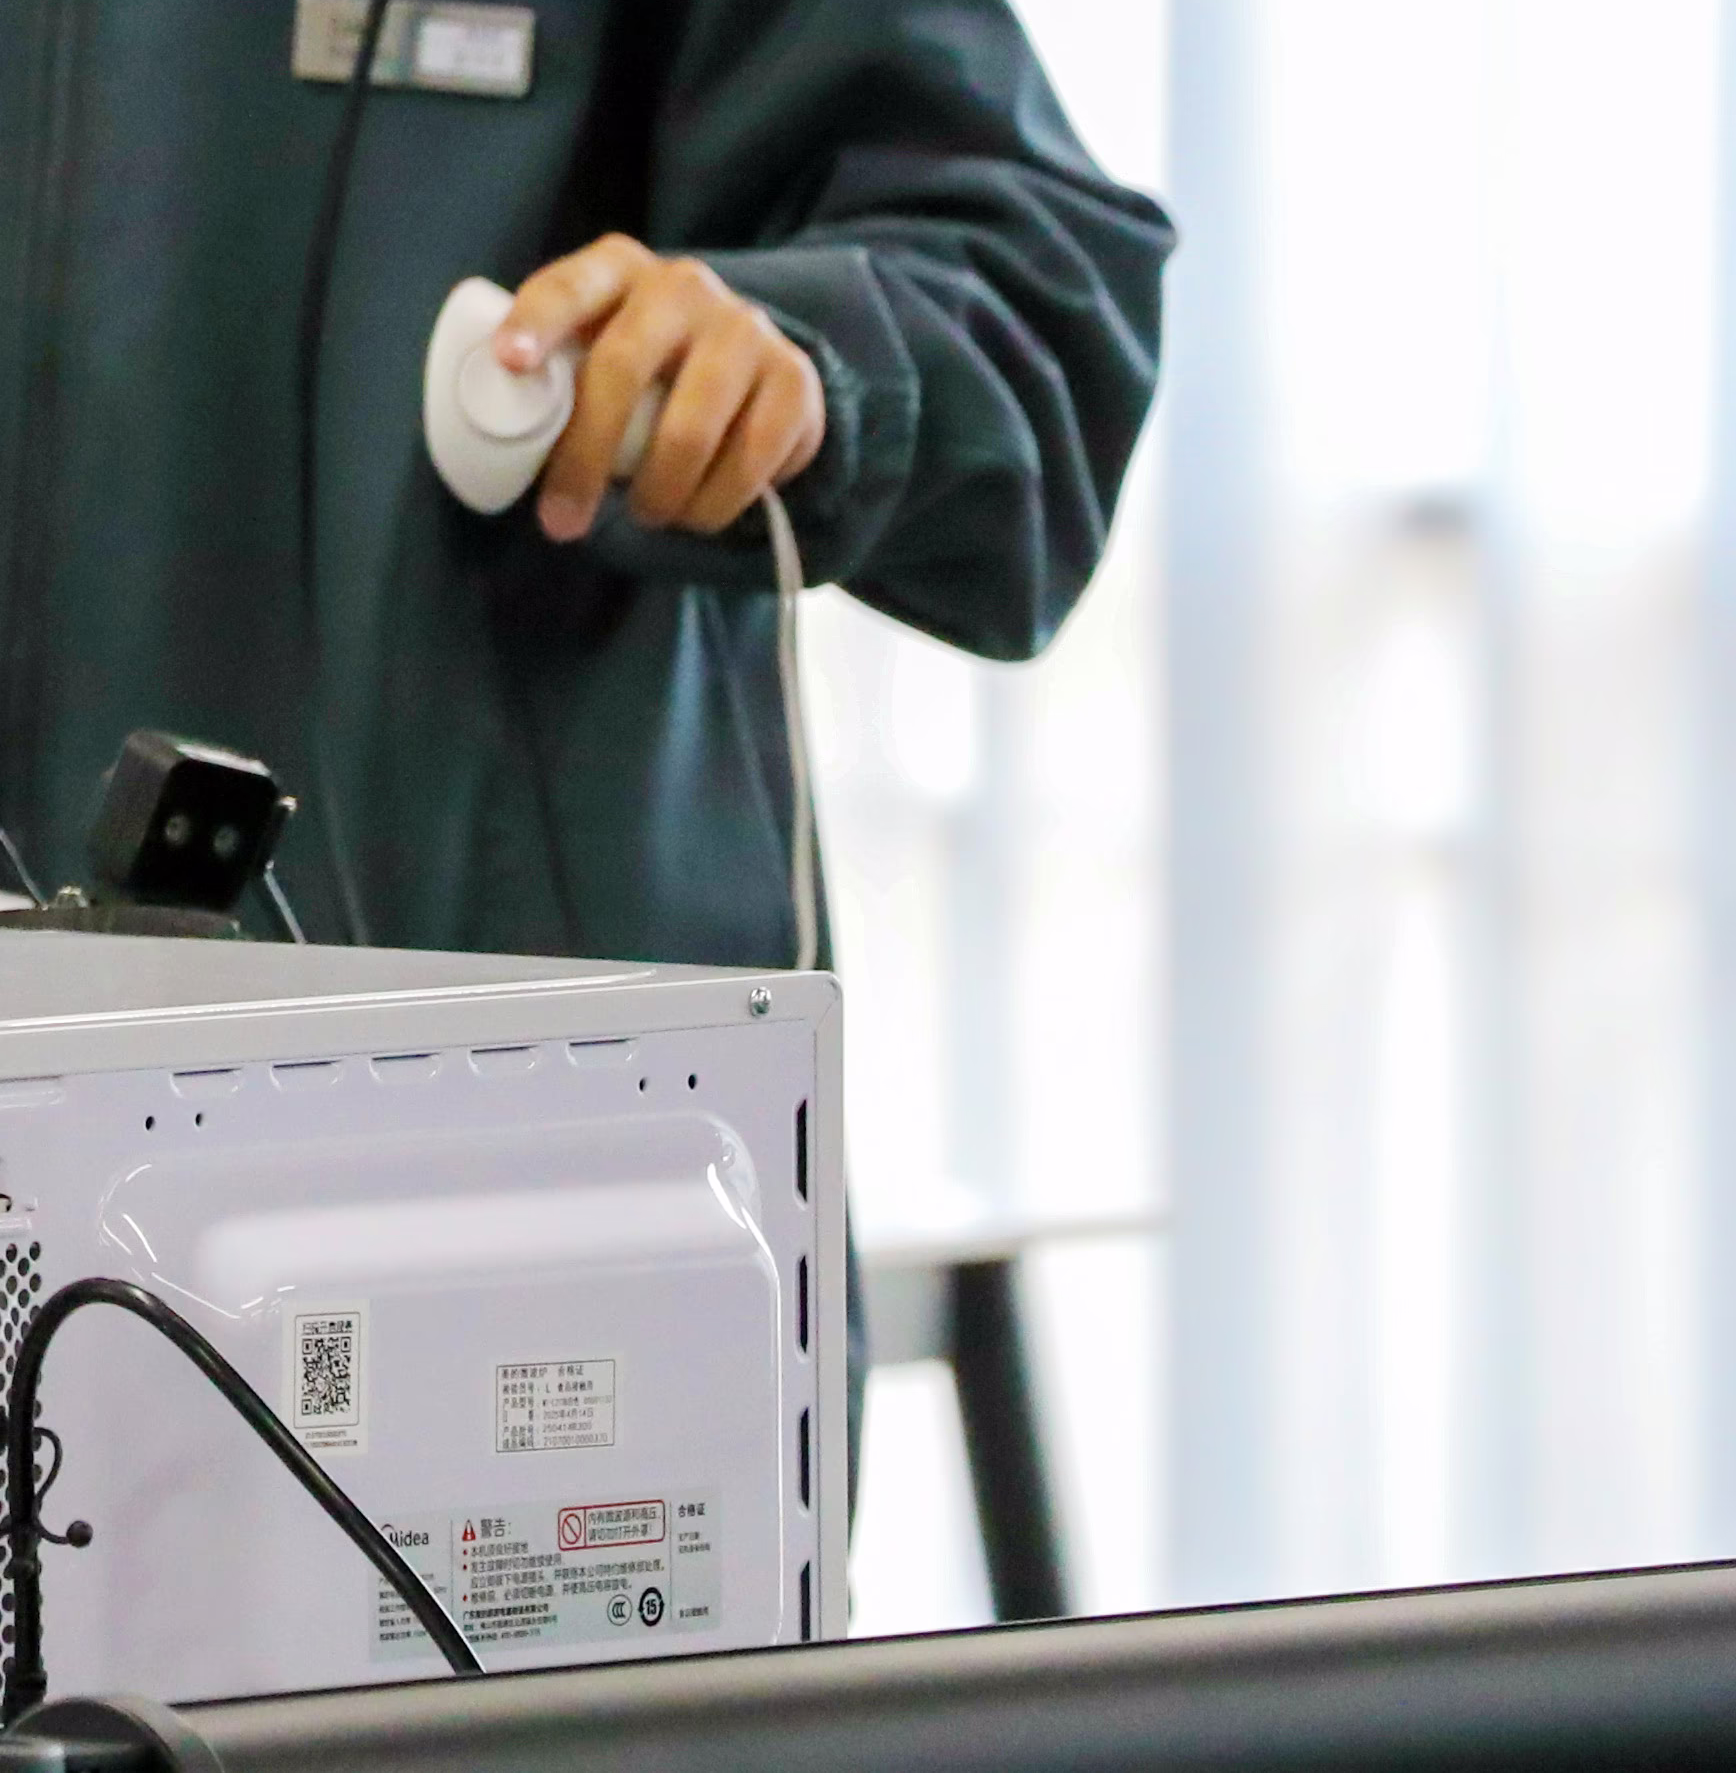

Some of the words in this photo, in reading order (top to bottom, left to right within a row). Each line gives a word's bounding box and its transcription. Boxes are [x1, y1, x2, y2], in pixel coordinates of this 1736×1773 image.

[678, 1502, 706, 1518] 合格证
[388, 1530, 430, 1548] Midea
[644, 1598, 657, 1616] 15
